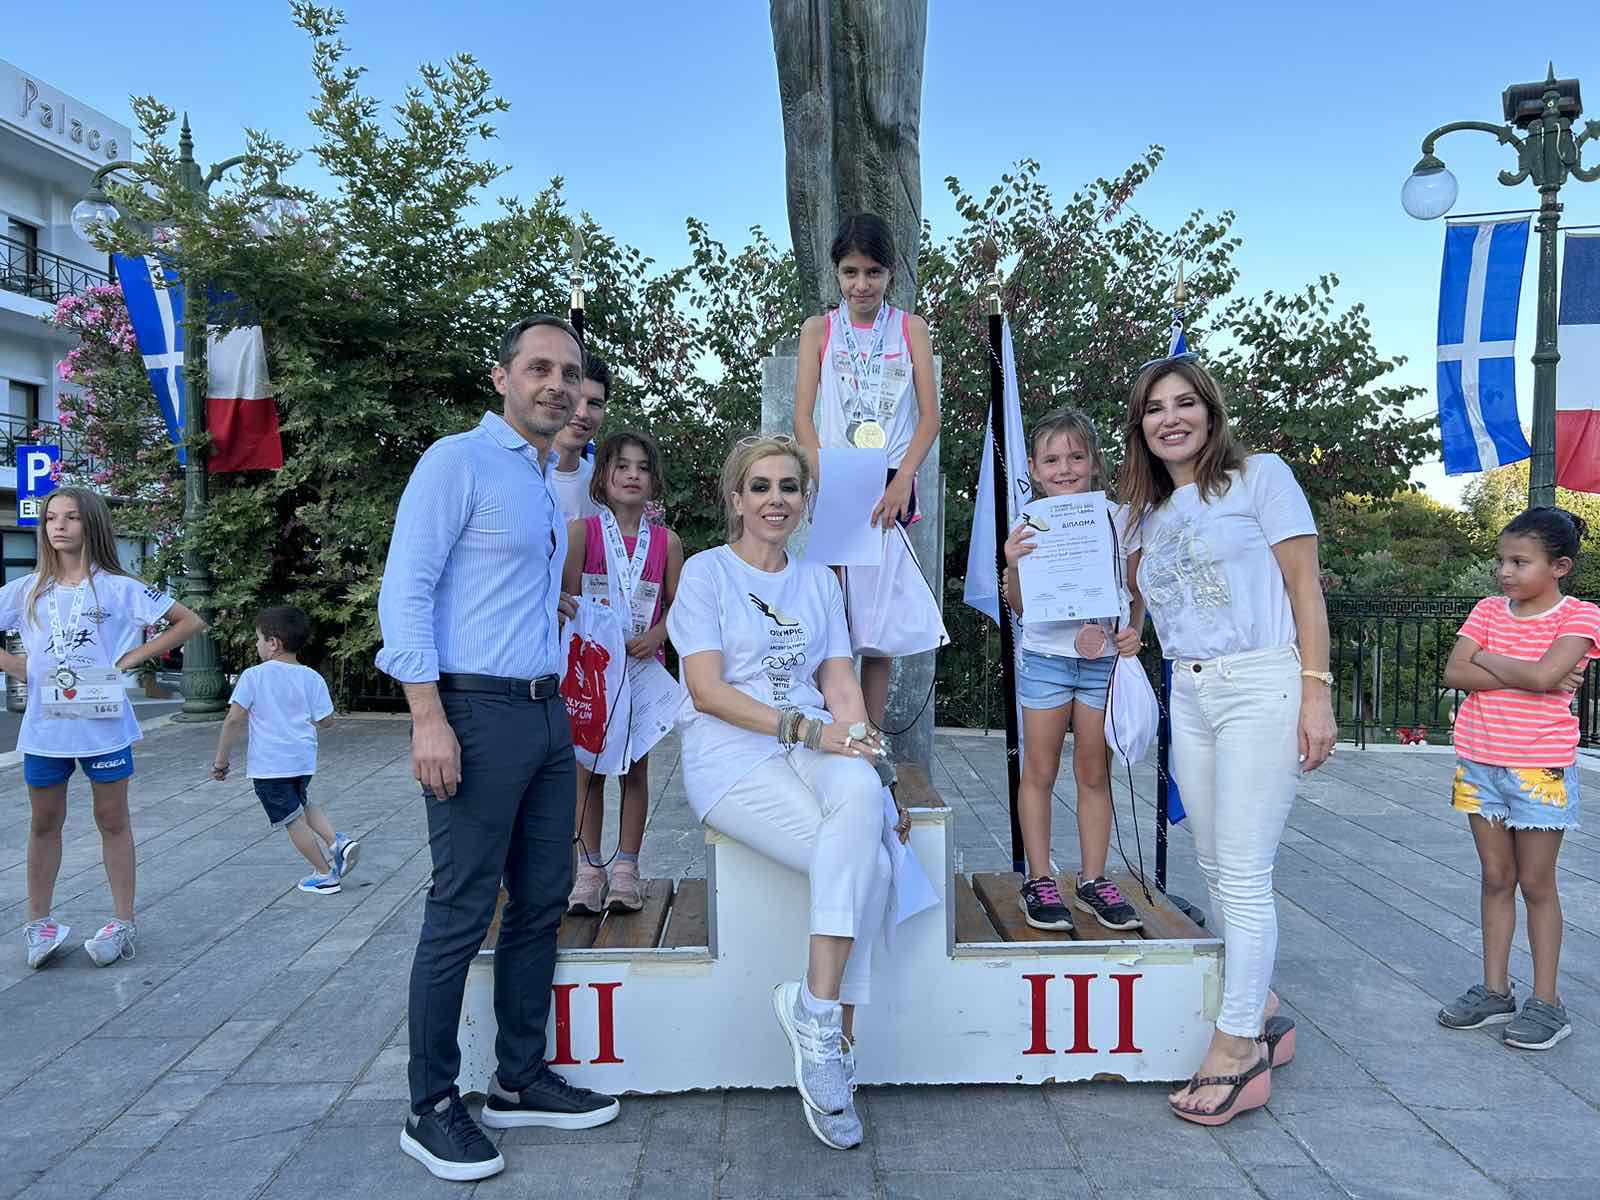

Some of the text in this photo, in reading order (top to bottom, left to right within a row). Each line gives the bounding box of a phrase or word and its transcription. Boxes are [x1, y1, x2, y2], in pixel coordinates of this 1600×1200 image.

[19, 78, 119, 161] Palace
[27, 452, 51, 491] P
[769, 628, 804, 637] OLYMPIC
[91, 758, 126, 769] LEGEA
[544, 982, 624, 1065] II
[1022, 974, 1143, 1055] III
